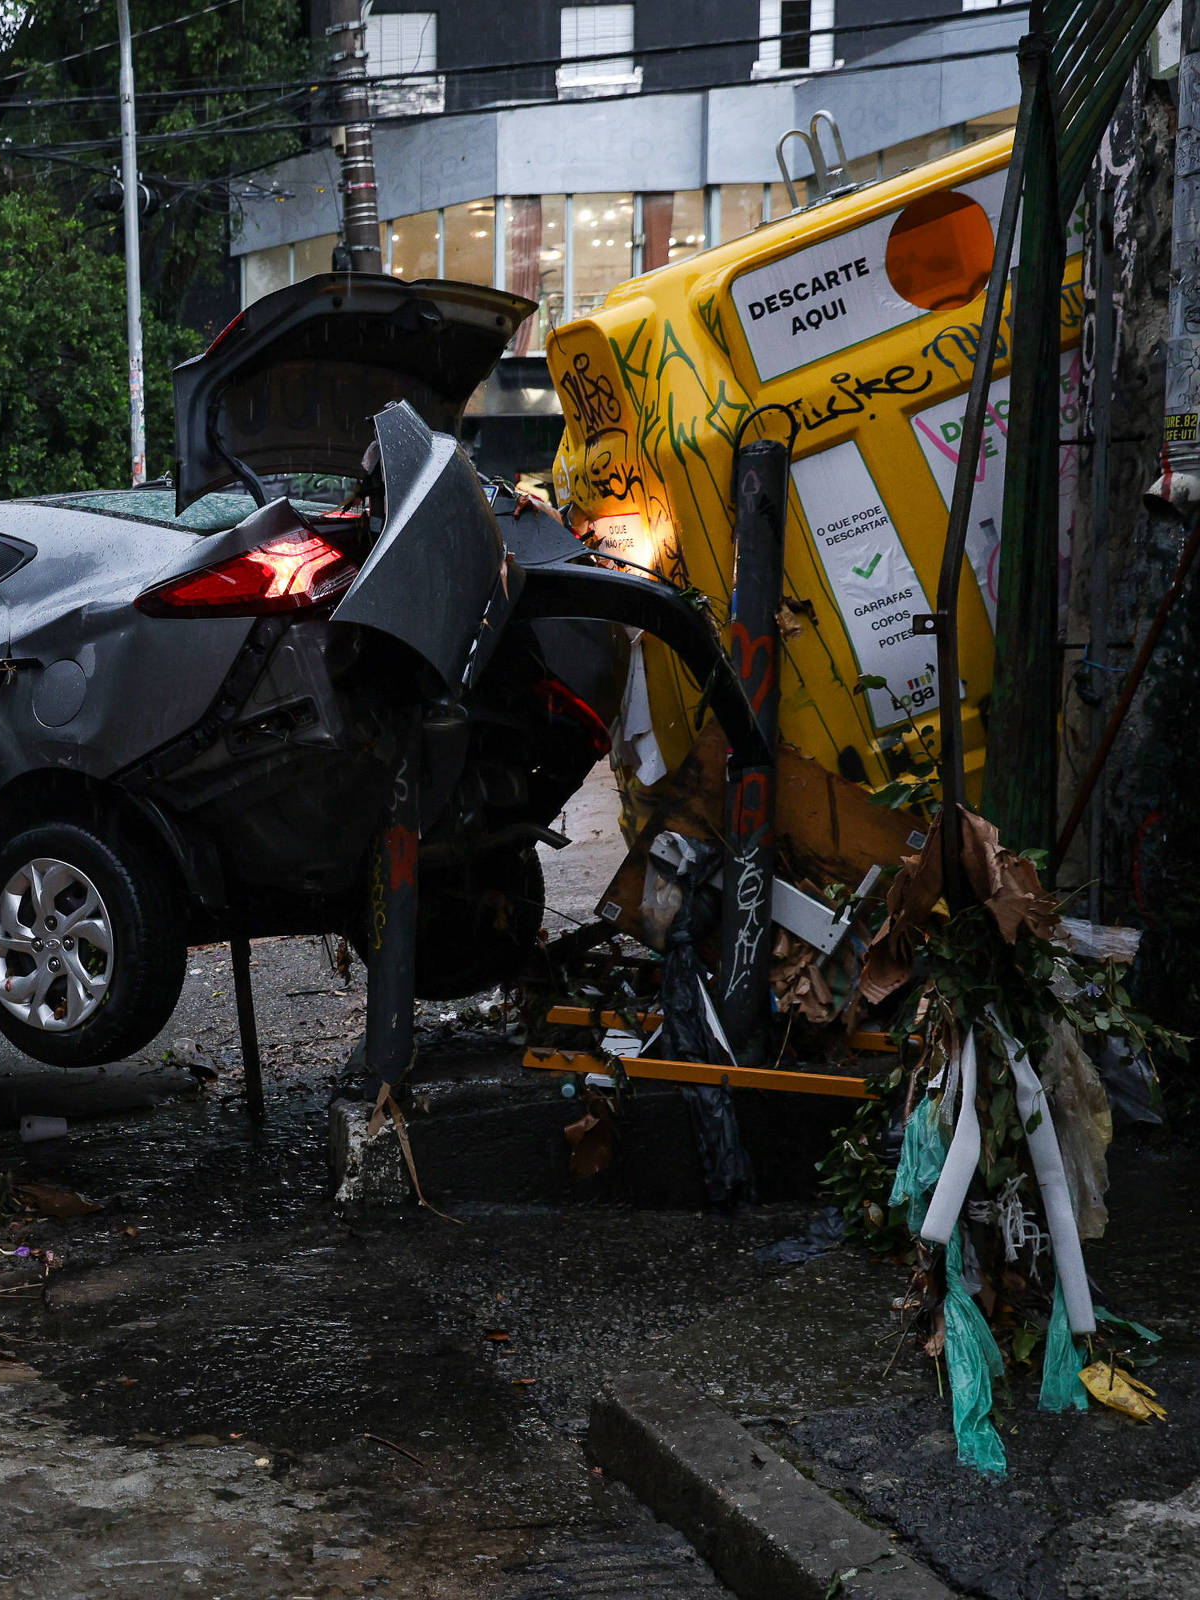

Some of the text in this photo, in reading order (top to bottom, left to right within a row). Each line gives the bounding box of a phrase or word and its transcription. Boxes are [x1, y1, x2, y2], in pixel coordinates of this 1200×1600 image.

[748, 257, 870, 320] DESCARTE
[791, 298, 847, 336] AQUI
[816, 505, 882, 537] O QUE PODE
[825, 516, 889, 547] DESCARTAR
[853, 588, 913, 617] GARRAFAS
[871, 610, 911, 632] COPOS
[878, 629, 915, 649] POTES
